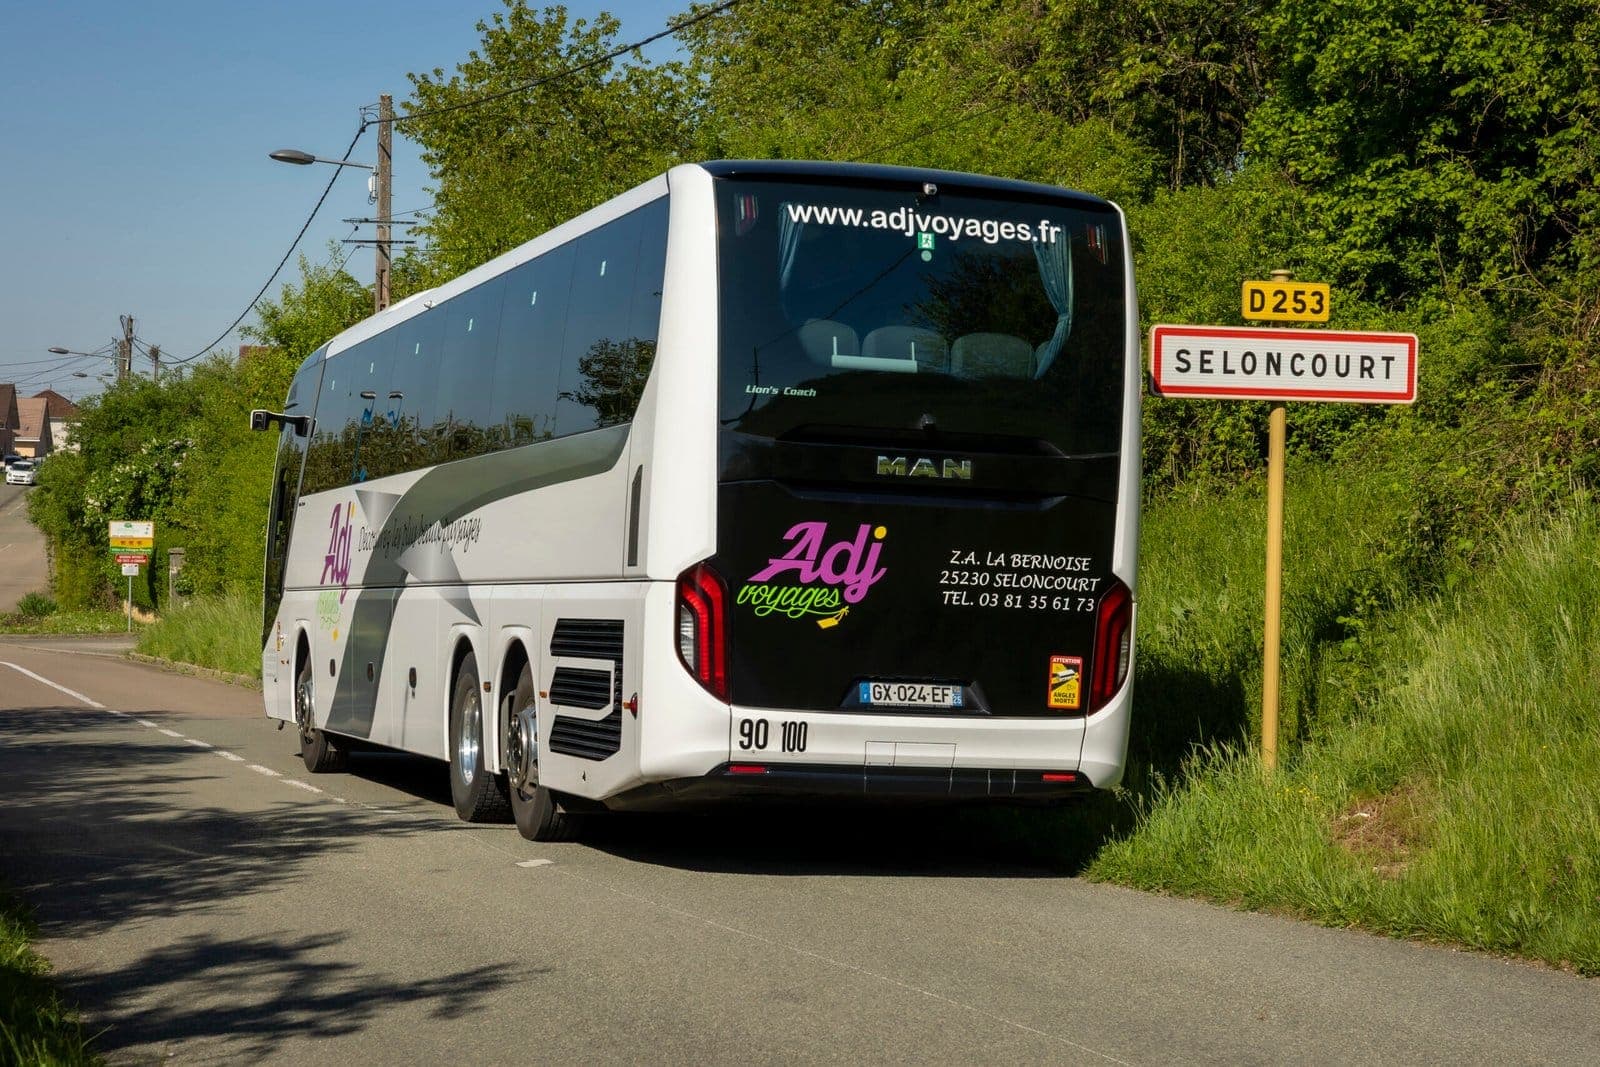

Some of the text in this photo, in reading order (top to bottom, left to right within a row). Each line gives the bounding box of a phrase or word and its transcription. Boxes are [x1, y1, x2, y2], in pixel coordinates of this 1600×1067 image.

[787, 203, 1061, 244] www.adjvoyages.fr
[1249, 288, 1325, 315] D 253
[1174, 348, 1396, 380] SELONCOURT
[745, 384, 817, 397] Lion's Coach
[876, 455, 972, 480] MAN
[746, 521, 887, 604] Adj
[950, 549, 1092, 571] Z.A. LA BERNOISE
[939, 570, 1101, 592] 25230 SELONCOURT
[736, 584, 842, 619] voyages
[942, 590, 1095, 612] TEL. 03 81 35 61 73
[872, 683, 951, 704] GX-024-EF
[739, 718, 808, 753] 90 100
